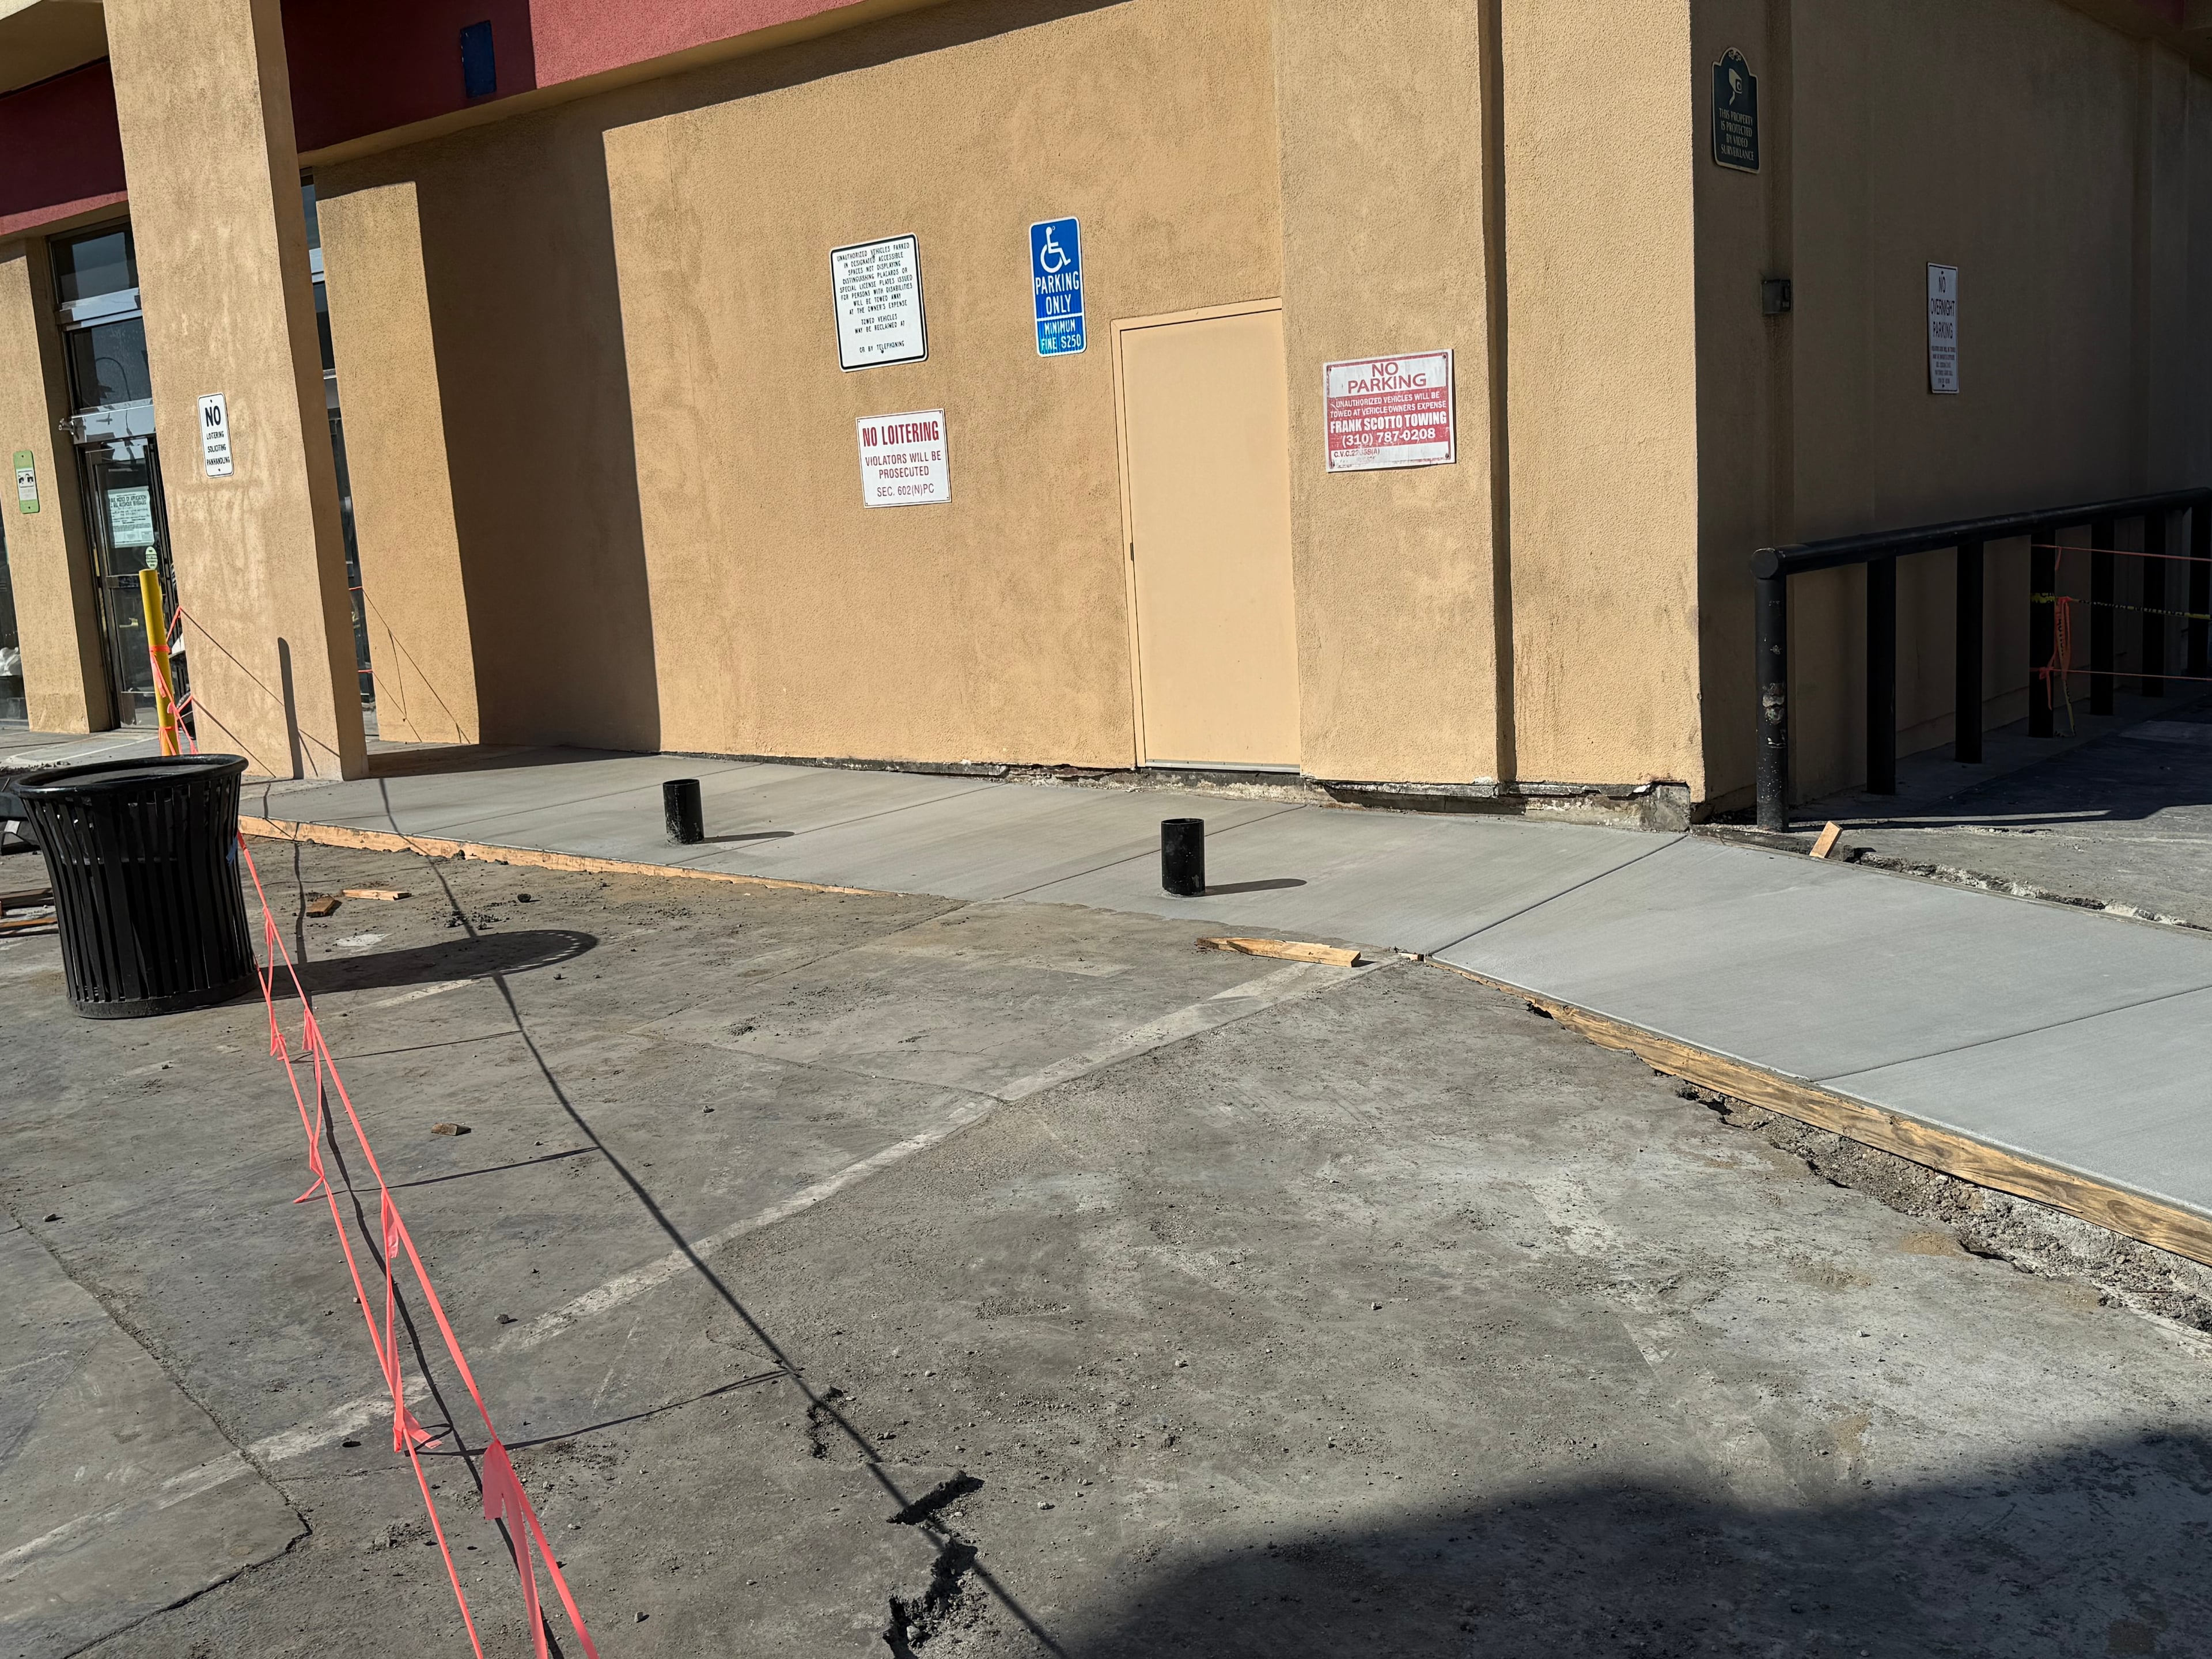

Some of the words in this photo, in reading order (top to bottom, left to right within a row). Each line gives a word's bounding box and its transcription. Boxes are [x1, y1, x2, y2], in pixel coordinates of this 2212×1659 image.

[1719, 108, 1729, 119] THIS
[1731, 111, 1752, 126] PROPERTY
[1721, 120, 1725, 130] IS
[1726, 122, 1752, 137] PROTECTED
[1726, 134, 1732, 143] BY
[1733, 135, 1748, 147] VIDEO
[1721, 144, 1754, 161] SURVEILLANCE
[837, 251, 867, 262] UNAUTHORIZED
[870, 246, 890, 256] VEHICLES
[893, 243, 909, 251] PARKED
[851, 257, 876, 267] DESIGNATED
[878, 252, 903, 262] ACCESSIBLE
[877, 260, 901, 270] DISPLAYING
[840, 285, 856, 293] SPECIAL
[859, 281, 876, 290] LICENSE
[880, 278, 895, 286] PLATES
[897, 274, 912, 282] ISSUED
[843, 274, 874, 285] DISTINGUISHING
[877, 268, 899, 278] PLACARDS
[1035, 271, 1080, 295] PARKING
[1939, 276, 1945, 293] NO
[852, 290, 870, 299] PERSONS
[887, 282, 912, 293] DISABILITIES
[868, 303, 885, 312] OWNER'S
[889, 300, 907, 309] EXPENSE
[1046, 294, 1071, 315] ONLY
[1931, 298, 1955, 316] OVERNIGHT
[877, 313, 897, 322] VEHICLES
[874, 323, 897, 331] RECLAIMED
[1044, 319, 1075, 335] MINIMUM
[1933, 321, 1953, 339] PARKING
[877, 340, 904, 351] TELEPHONING
[1041, 337, 1056, 351] FINE
[1061, 334, 1081, 349] $250
[1372, 362, 1399, 377] NO
[1348, 373, 1426, 394] PARKING
[1336, 397, 1382, 408] UNAUTHORIZED
[1383, 393, 1412, 404] VEHICLES
[1414, 392, 1430, 400] WILL
[1362, 407, 1388, 415] VEHICLE
[1388, 403, 1415, 412] OWNERS
[1417, 401, 1446, 410] EXPENSE
[205, 406, 221, 427] NO
[1330, 419, 1362, 434] FRANK
[1364, 415, 1403, 431] SCOTTO
[1404, 411, 1447, 427] TOWING
[206, 431, 224, 440] LOITERING
[862, 427, 877, 447] NO
[881, 421, 939, 445] LOITERING
[1342, 433, 1373, 448] (310)
[1377, 428, 1435, 443] 787-0208
[207, 444, 226, 453] SOLICITING
[207, 456, 230, 466] PANHANDLING
[865, 453, 907, 466] VIOLATORS
[909, 452, 929, 463] WILL
[931, 450, 941, 461] BE
[879, 465, 929, 479] PROSECUTED
[877, 486, 895, 497] SEC.
